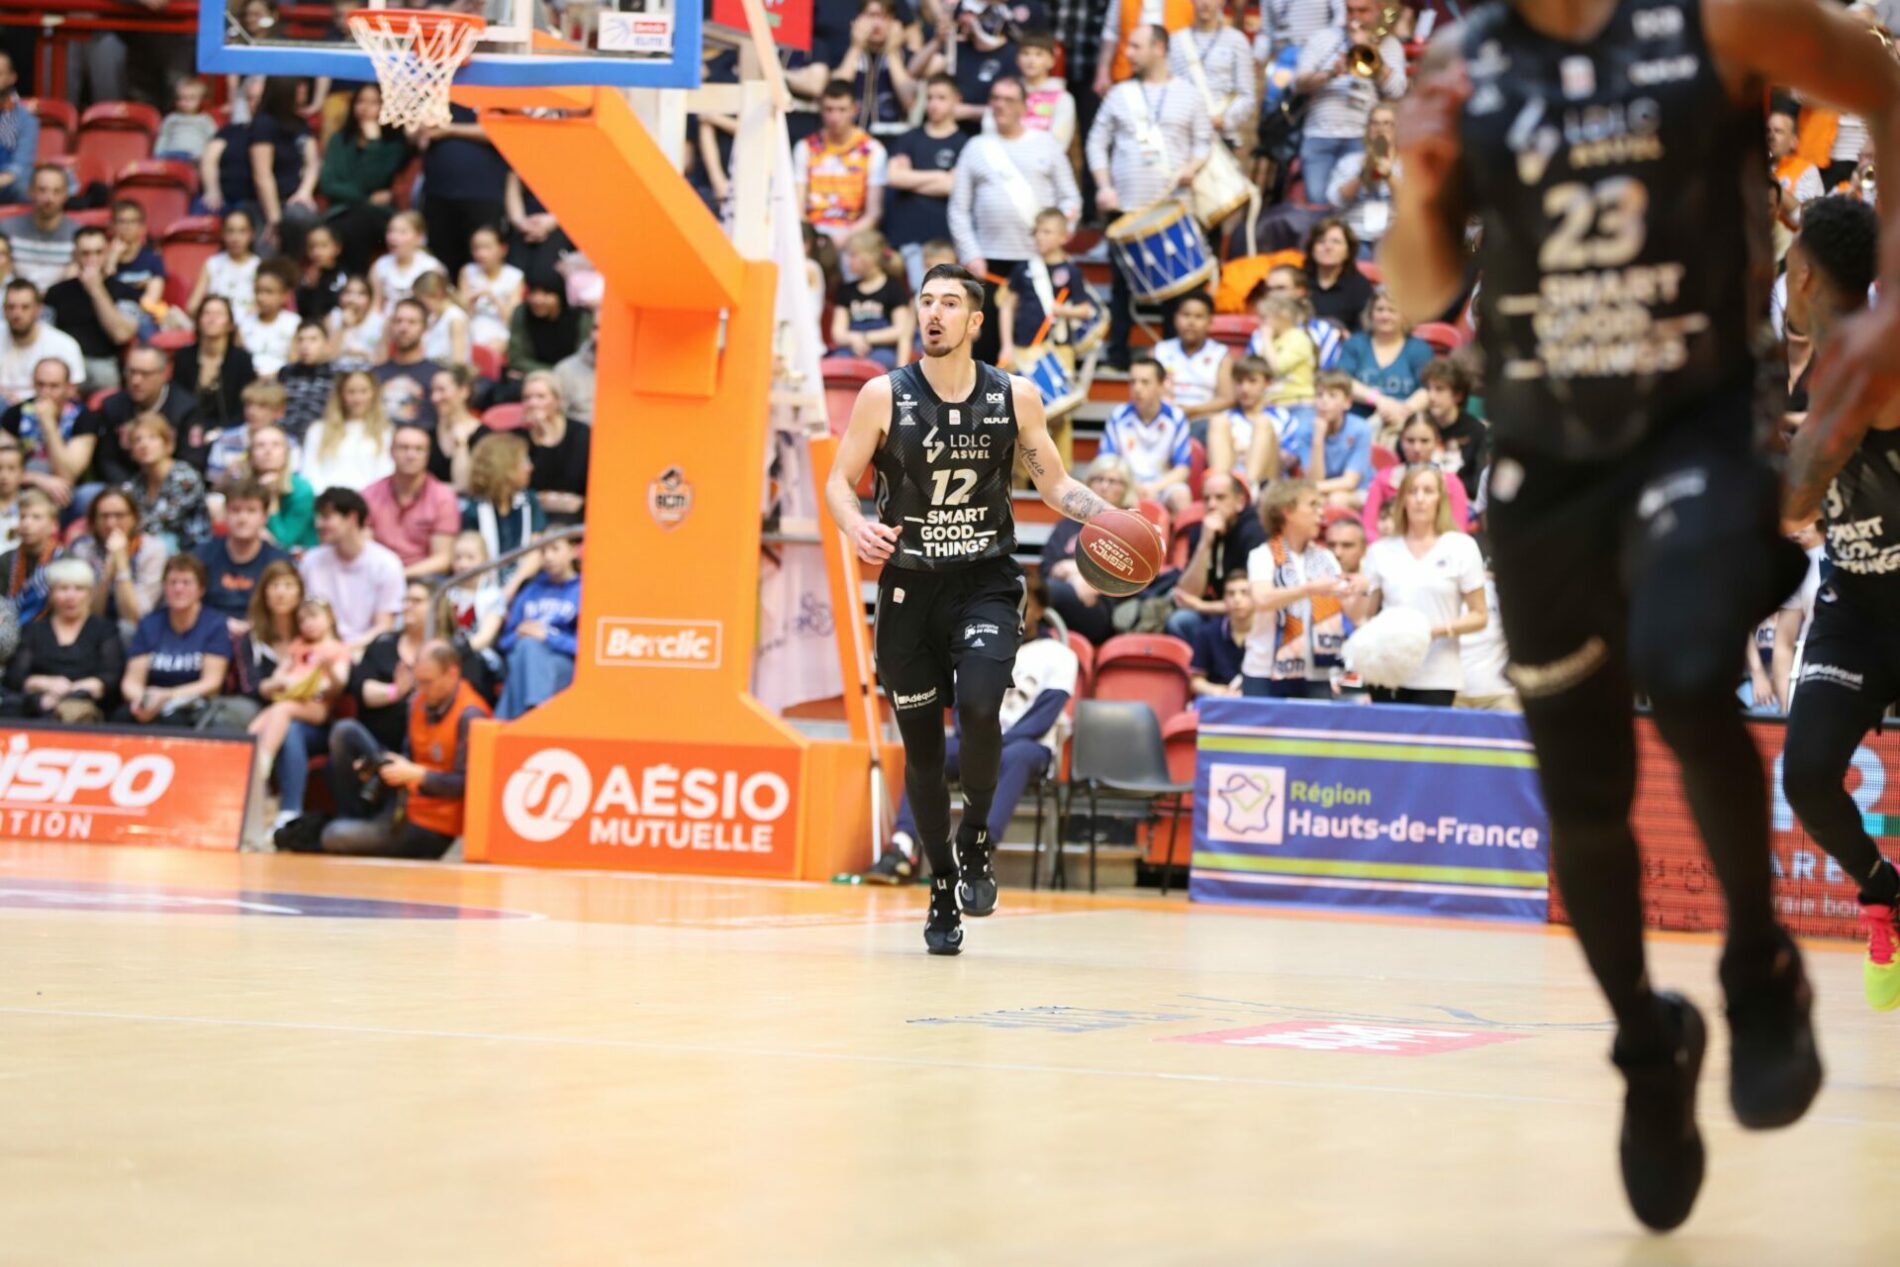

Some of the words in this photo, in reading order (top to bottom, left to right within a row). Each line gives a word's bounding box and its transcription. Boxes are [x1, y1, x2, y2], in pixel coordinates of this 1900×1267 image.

[1538, 174, 1650, 272] 23
[950, 434, 991, 449] LDLC
[950, 449, 990, 460] ASVEL
[930, 468, 978, 506] 12
[926, 507, 989, 525] SMART
[920, 525, 975, 541] GOOD
[922, 537, 990, 558] THINGS
[1089, 541, 1134, 576] LEGACY
[0, 732, 176, 807] iSPO
[592, 762, 790, 822] AÉSIO
[1289, 779, 1372, 808] Région
[0, 808, 93, 839] TION
[589, 817, 774, 854] MUTUELLE
[1287, 808, 1540, 850] Hauts-de-France
